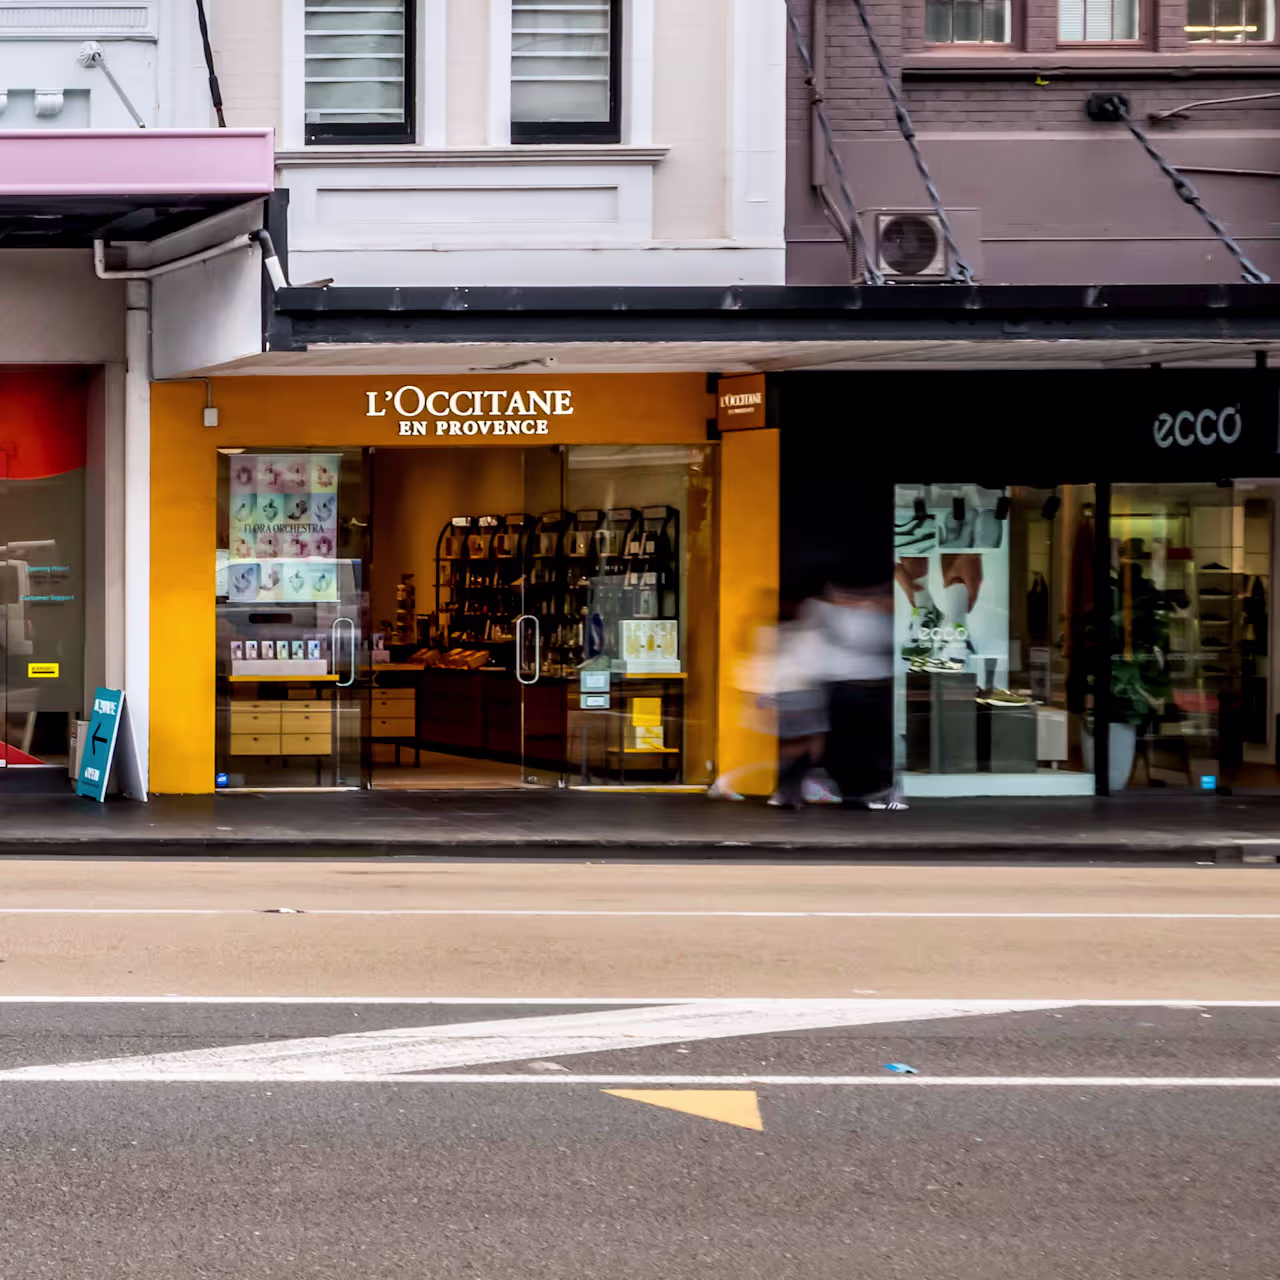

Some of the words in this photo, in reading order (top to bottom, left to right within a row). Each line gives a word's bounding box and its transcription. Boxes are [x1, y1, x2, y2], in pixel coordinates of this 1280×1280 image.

[366, 385, 574, 416] L'OCCITANE
[399, 421, 427, 436] EN
[436, 420, 548, 435] PROVENCE
[1153, 406, 1242, 448] ecco
[244, 523, 271, 534] FLORA
[273, 523, 325, 534] ORCHESTRA
